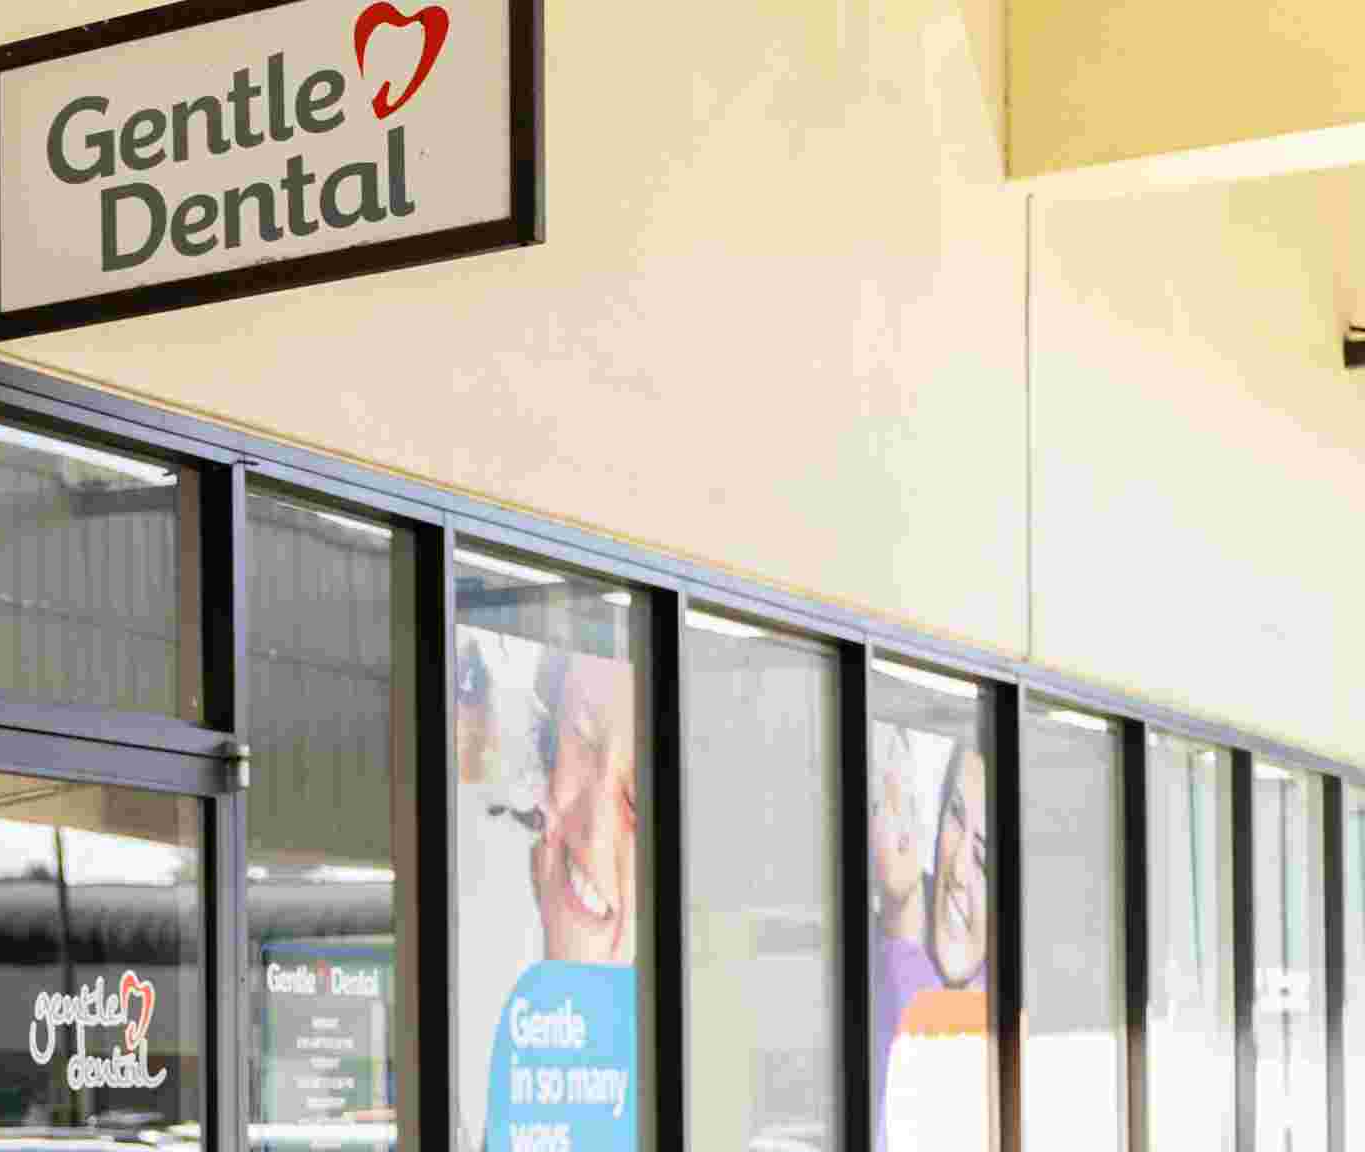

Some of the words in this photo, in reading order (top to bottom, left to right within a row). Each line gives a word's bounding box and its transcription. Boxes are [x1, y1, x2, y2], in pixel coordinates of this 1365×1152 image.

[46, 51, 346, 185] Gentle
[100, 125, 415, 273] Dental
[29, 976, 127, 1064] gentle
[67, 1021, 167, 1090] dental
[509, 997, 588, 1048] Gentle
